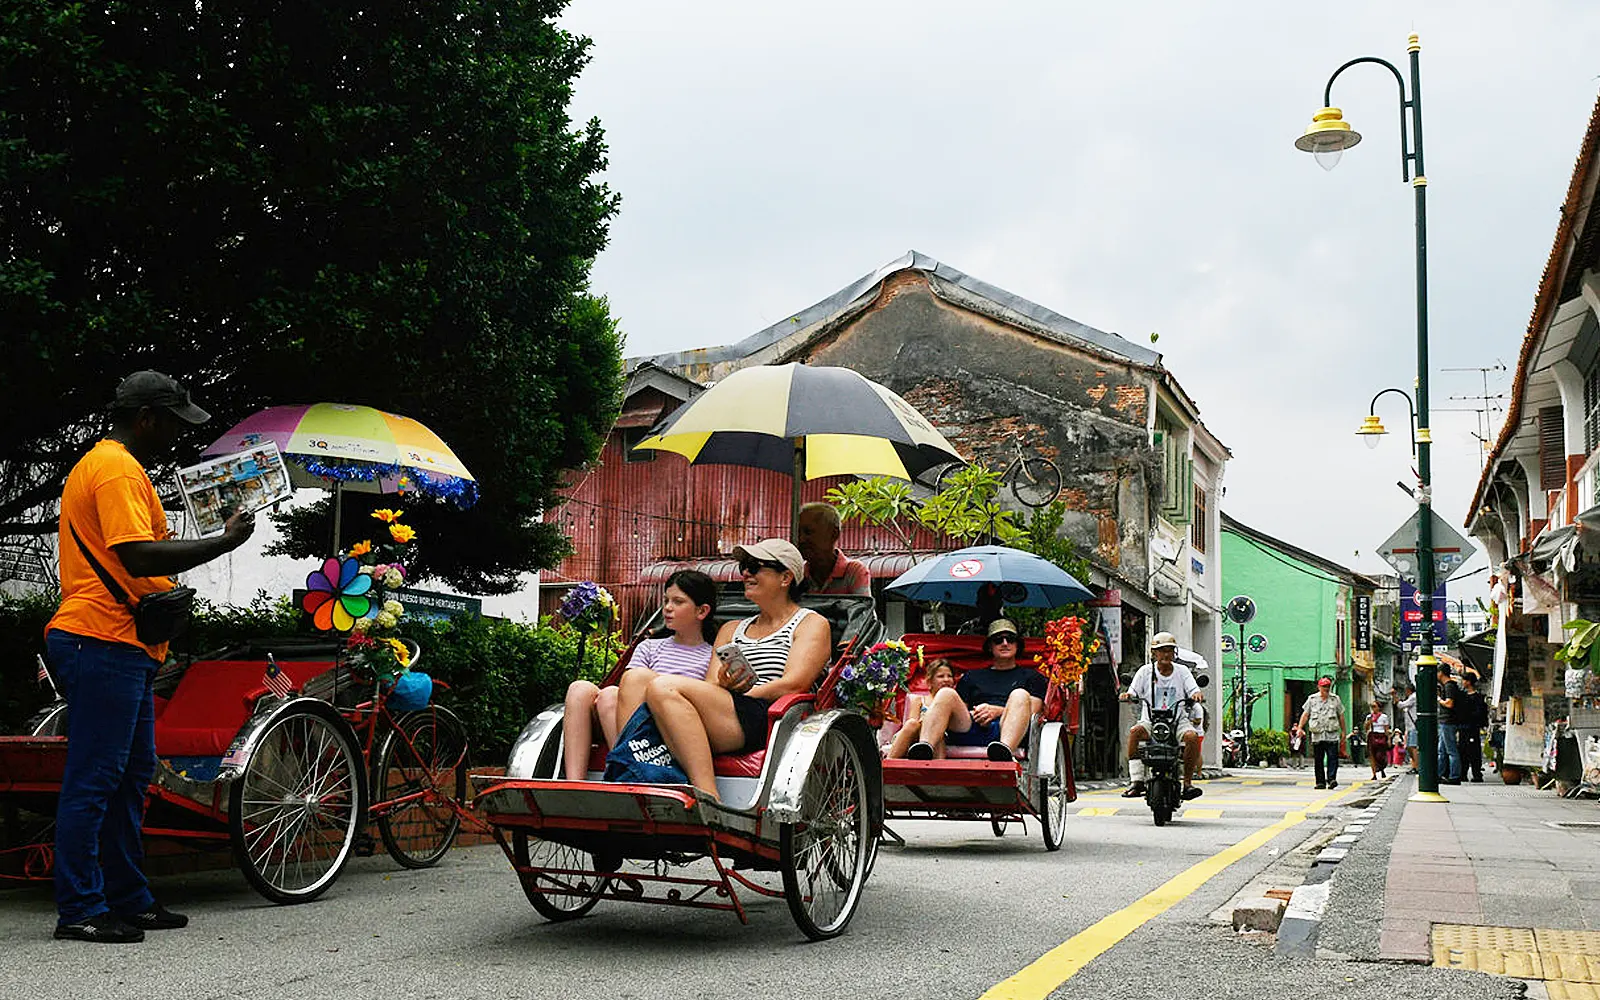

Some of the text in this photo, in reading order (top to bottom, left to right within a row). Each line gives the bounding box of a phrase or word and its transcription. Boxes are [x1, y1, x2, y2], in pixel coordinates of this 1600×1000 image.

[400, 593, 418, 604] UNESCO
[420, 596, 435, 606] WORLD
[436, 598, 456, 609] HERITAGE
[457, 602, 466, 611] SITE
[628, 739, 650, 751] the
[633, 744, 667, 762] Nottin
